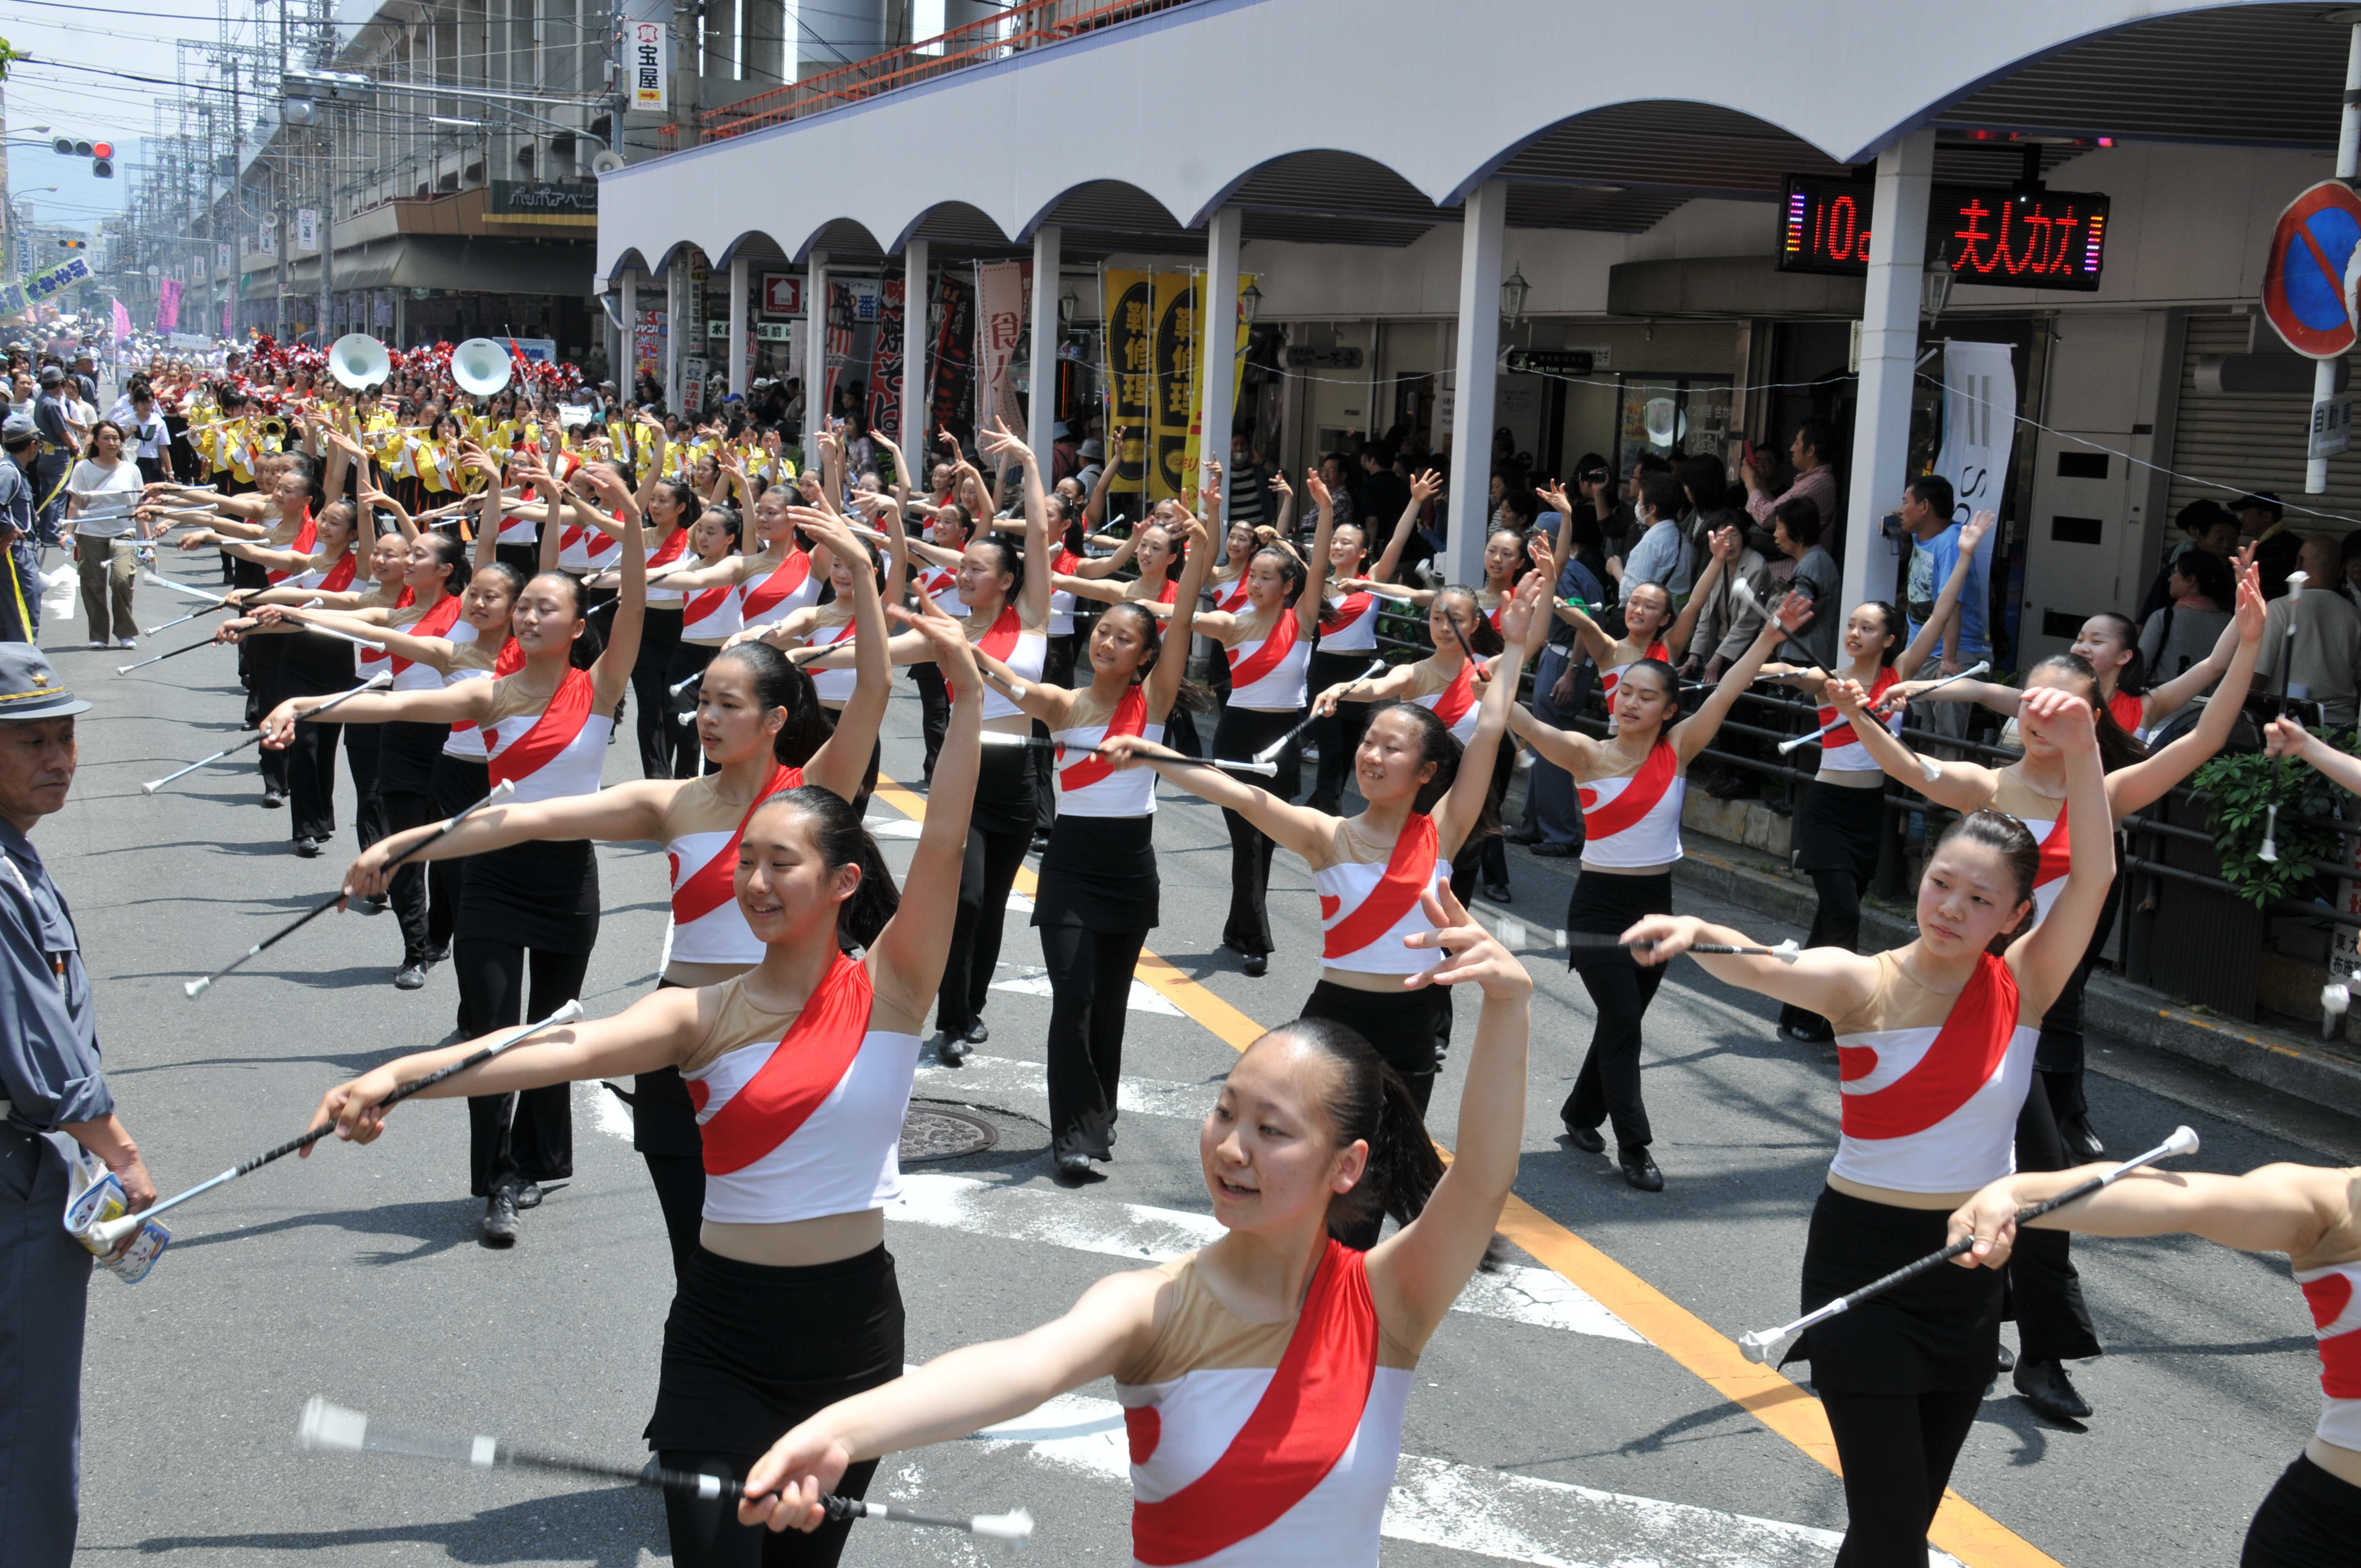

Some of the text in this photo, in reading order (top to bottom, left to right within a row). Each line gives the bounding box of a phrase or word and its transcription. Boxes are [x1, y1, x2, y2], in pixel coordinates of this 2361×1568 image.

[638, 45, 658, 89] 宝屋
[509, 186, 598, 209] ポッポアベニ
[1122, 301, 1152, 406] 靴修理
